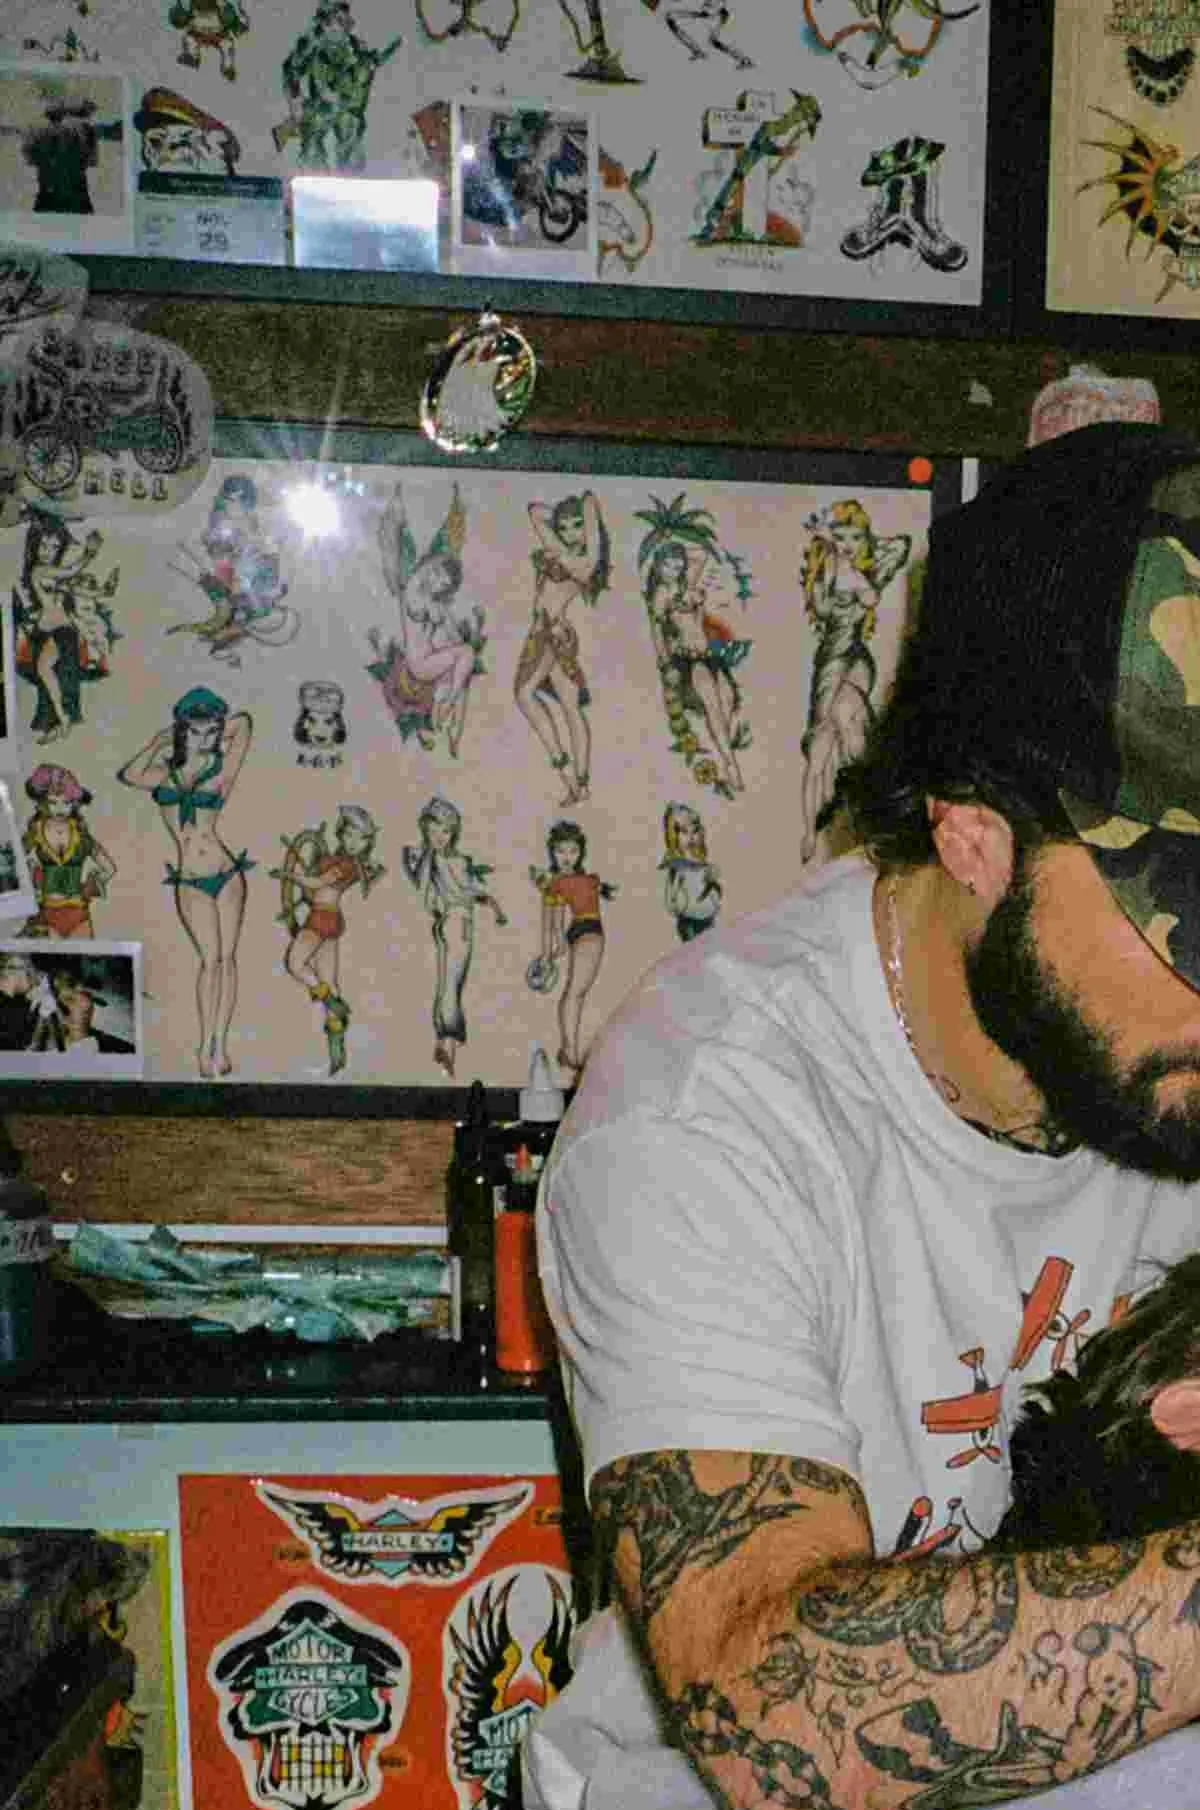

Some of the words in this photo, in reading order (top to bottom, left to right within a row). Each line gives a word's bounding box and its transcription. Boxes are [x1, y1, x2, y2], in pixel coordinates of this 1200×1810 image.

[352, 1534, 440, 1549] HARLEY
[272, 1634, 346, 1661] MOTOR
[271, 1666, 354, 1686] HARLEY
